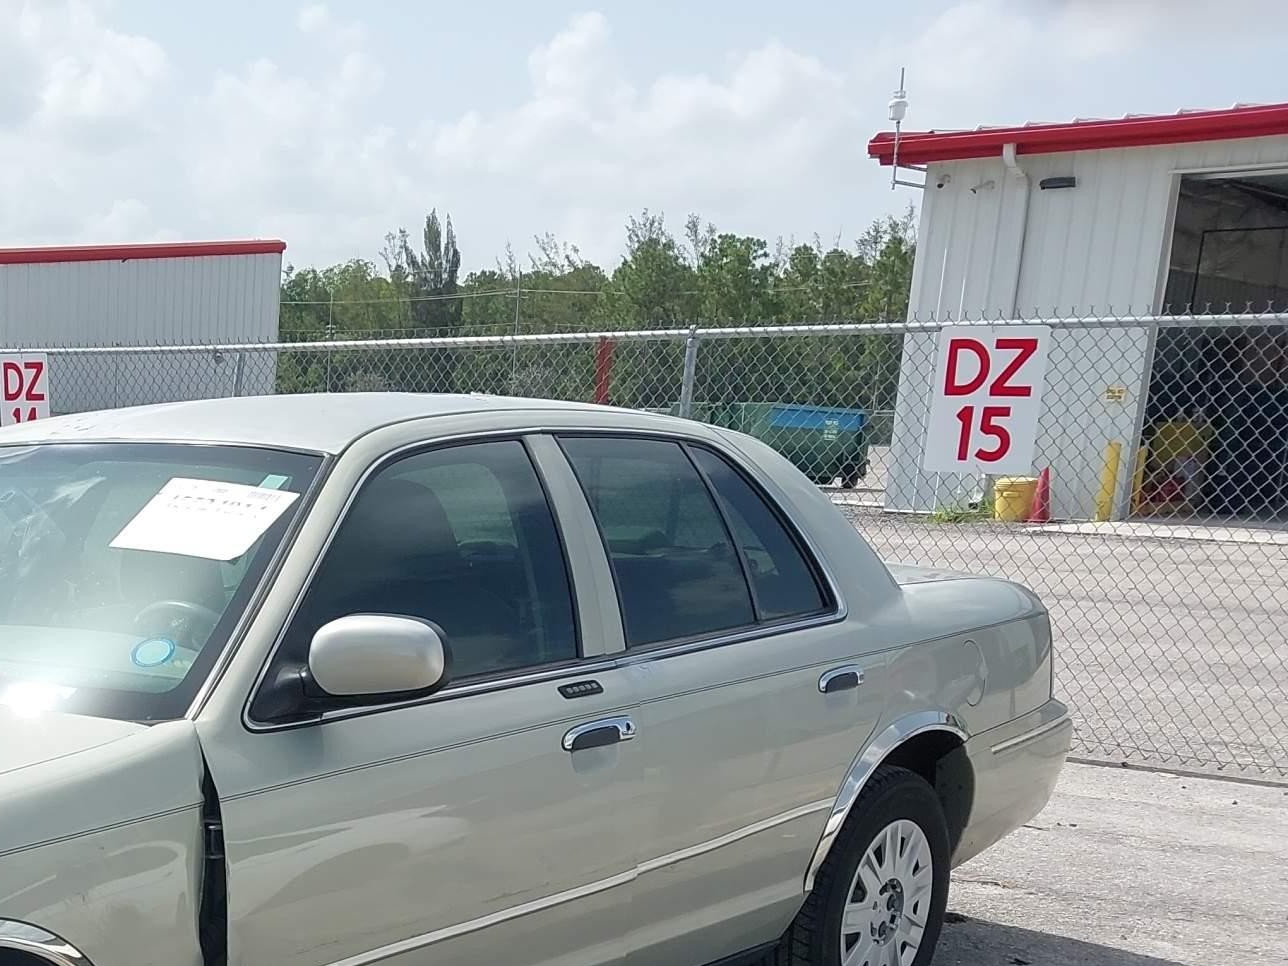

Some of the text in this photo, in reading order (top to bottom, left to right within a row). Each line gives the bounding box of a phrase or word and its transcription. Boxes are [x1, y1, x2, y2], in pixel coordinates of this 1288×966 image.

[2, 361, 45, 401] DZ
[943, 338, 1039, 397] DZ
[956, 405, 1012, 462] 15
